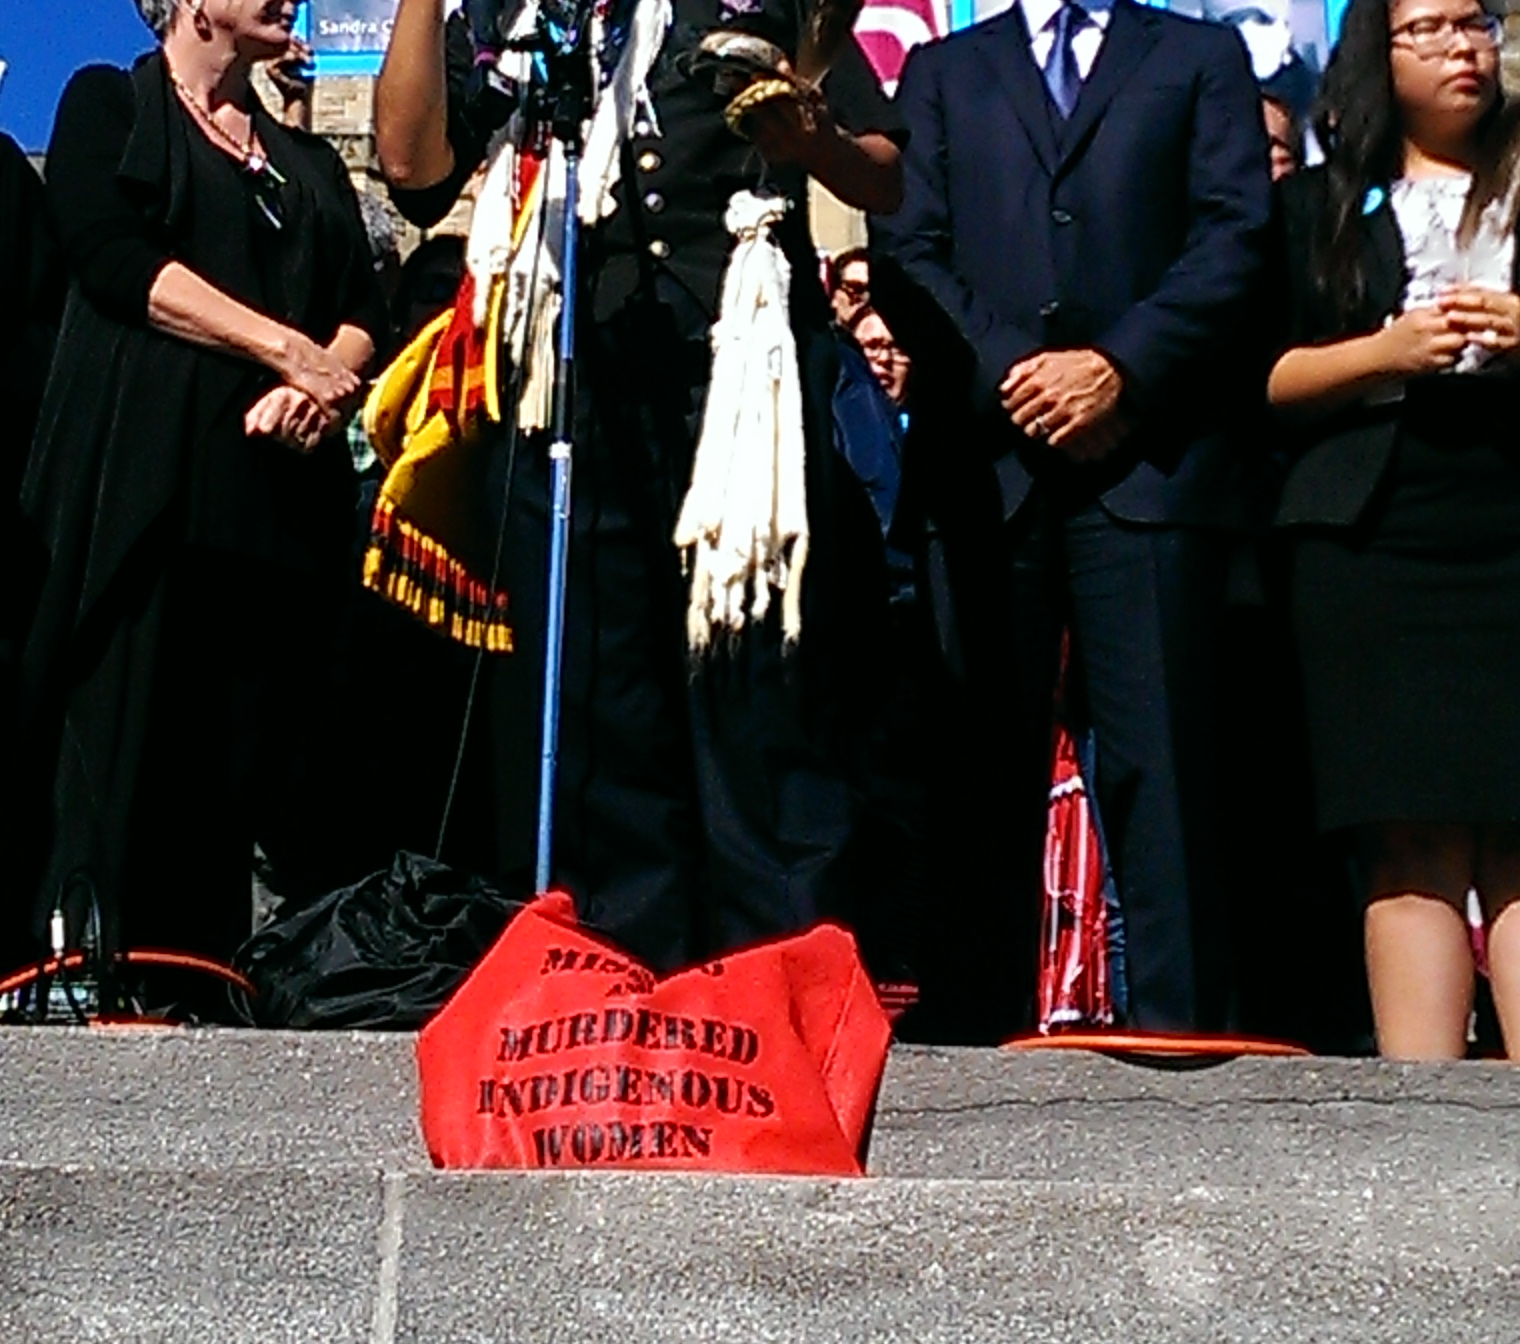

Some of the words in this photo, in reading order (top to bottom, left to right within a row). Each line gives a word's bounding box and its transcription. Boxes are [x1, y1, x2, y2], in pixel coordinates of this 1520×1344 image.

[319, 19, 378, 35] Sandra
[496, 1008, 759, 1065] MURDERED
[476, 1064, 775, 1117] INDIGENOUS
[532, 1121, 713, 1166] WOMEN
